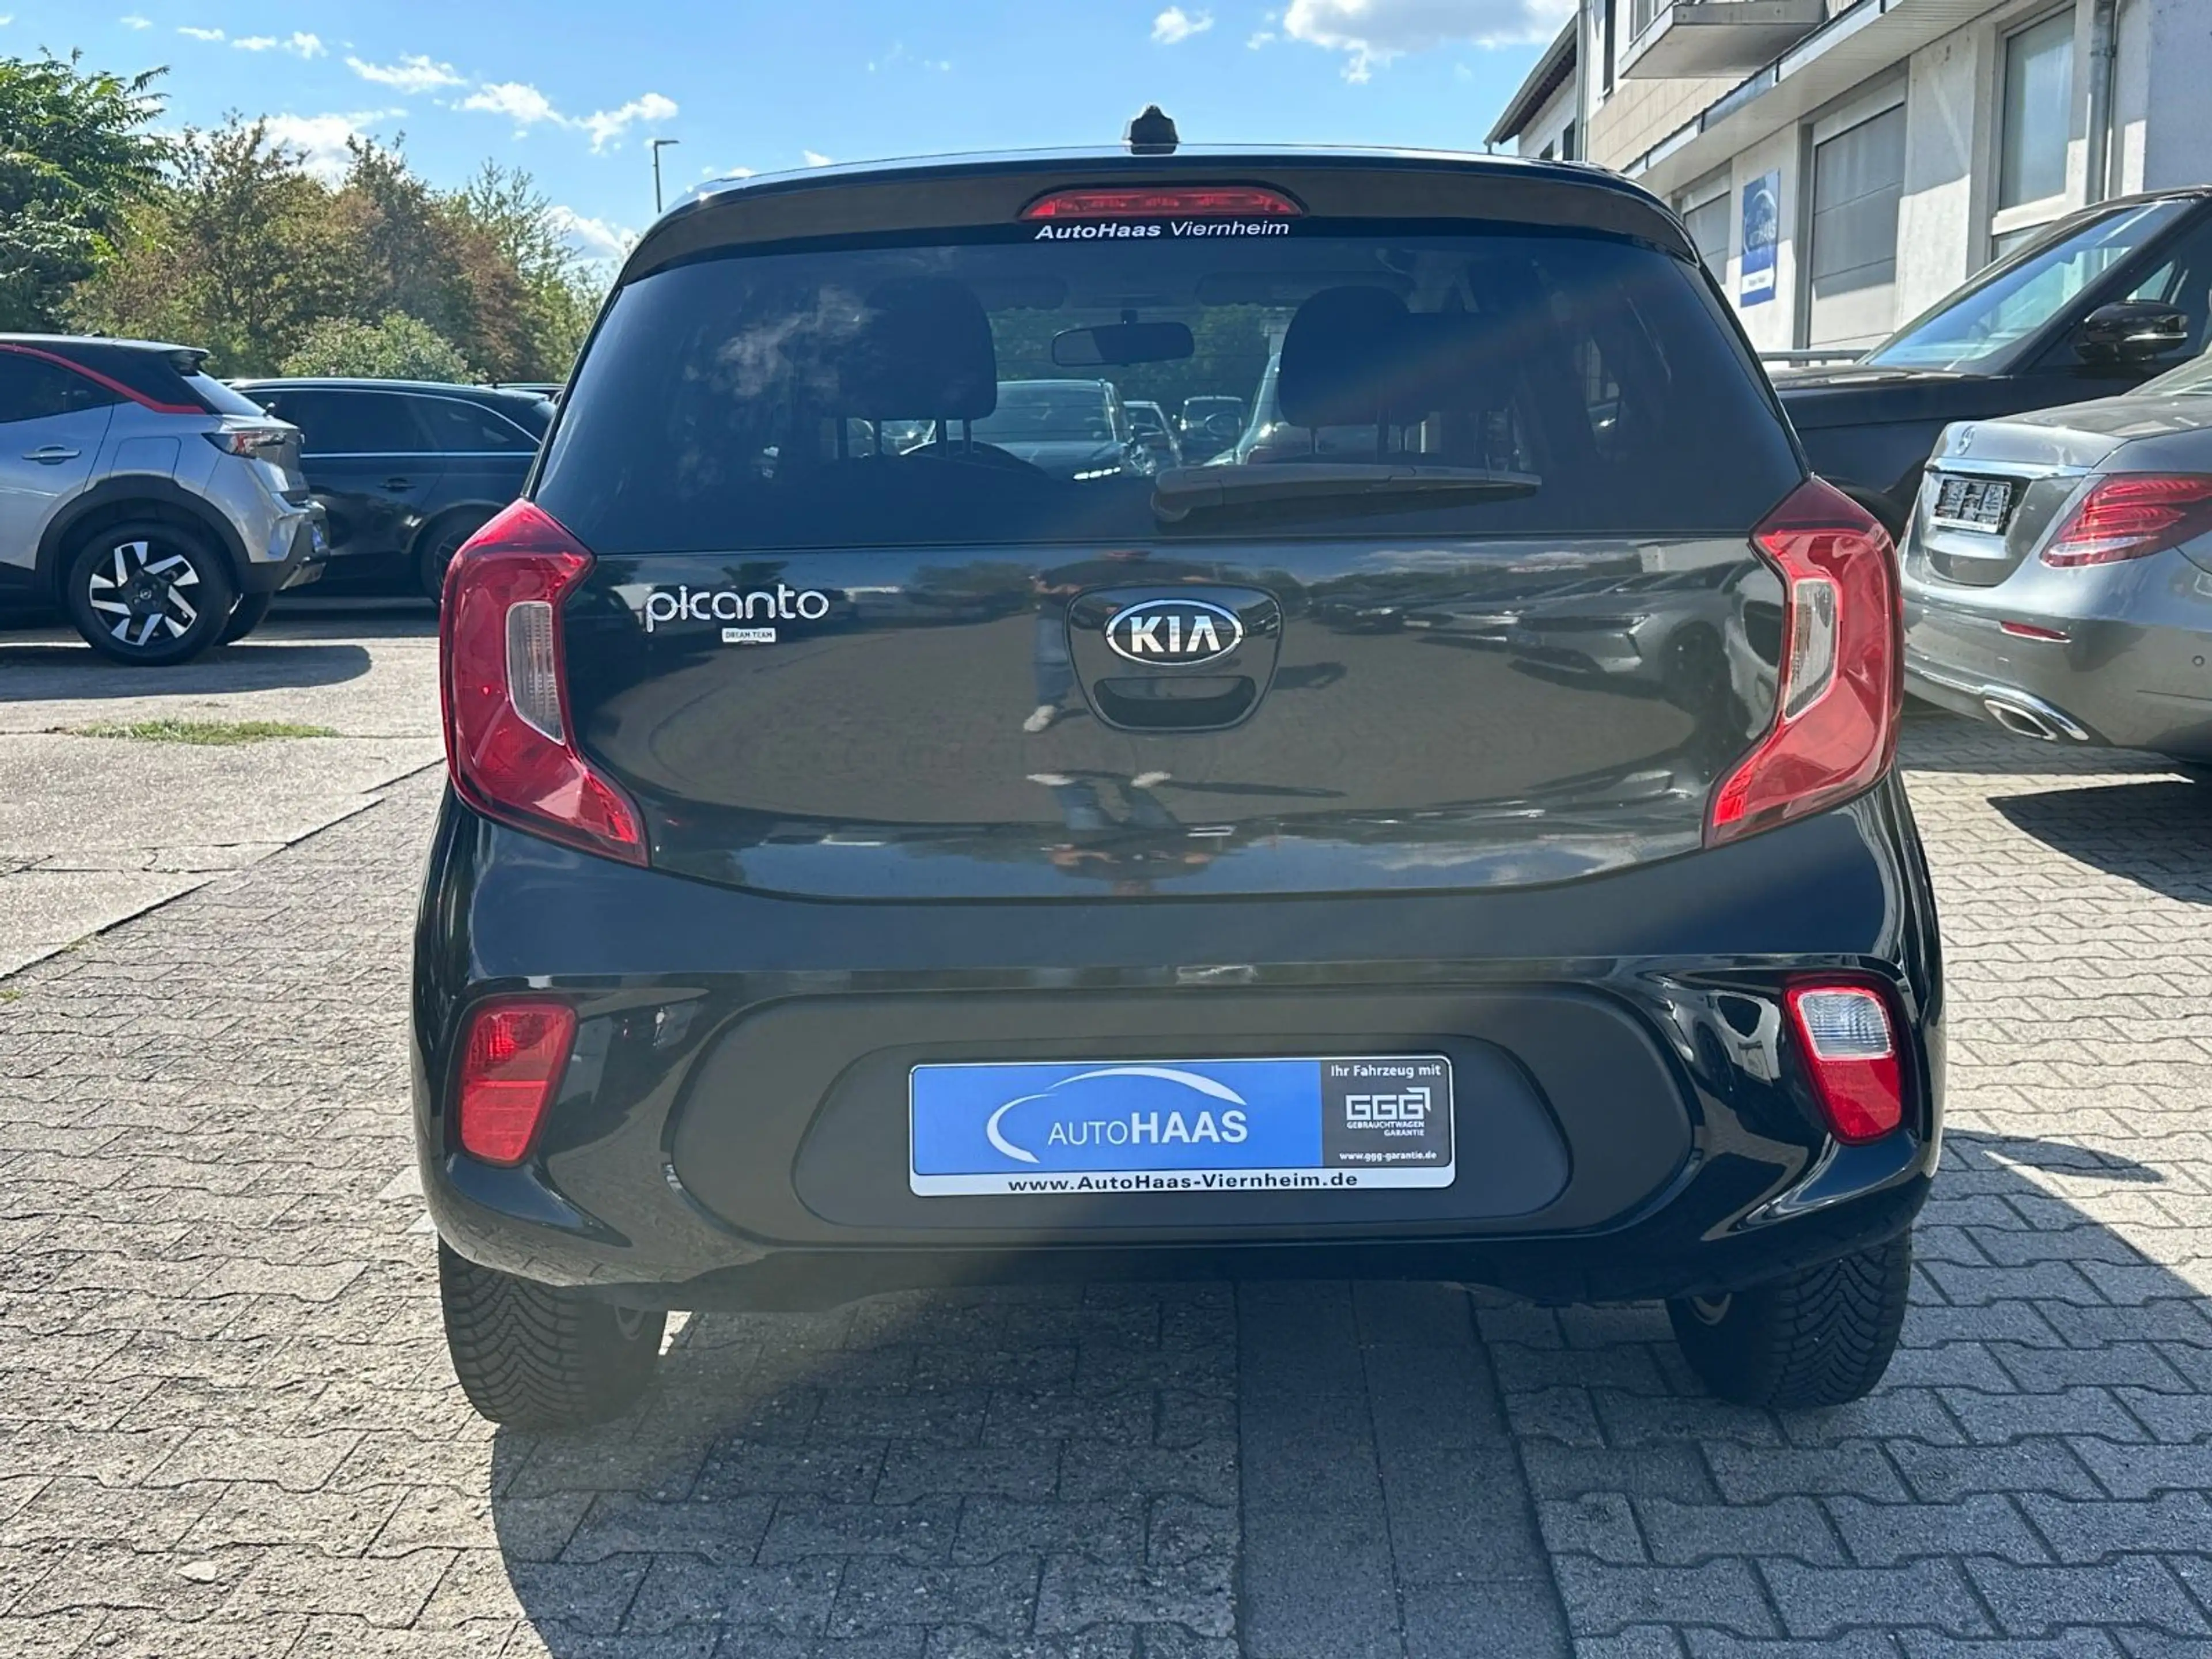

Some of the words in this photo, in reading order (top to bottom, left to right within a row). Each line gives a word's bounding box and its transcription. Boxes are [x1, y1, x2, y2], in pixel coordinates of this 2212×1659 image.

[1035, 224, 1161, 240] AutoHaas
[1170, 221, 1289, 236] Viernheim
[646, 584, 829, 632] picanto
[1130, 615, 1221, 653] KIA
[1331, 1065, 1349, 1077] Ihr
[1353, 1065, 1415, 1078] Fahrzeug
[1418, 1064, 1442, 1075] mit
[1346, 1094, 1424, 1120] GGG
[1346, 1120, 1425, 1129] GEBRAUCHTWAGEN
[1339, 1151, 1437, 1162] www.ggg-garantie.de
[1008, 1172, 1358, 1192] www.AutoHaas-Viernheim.de
